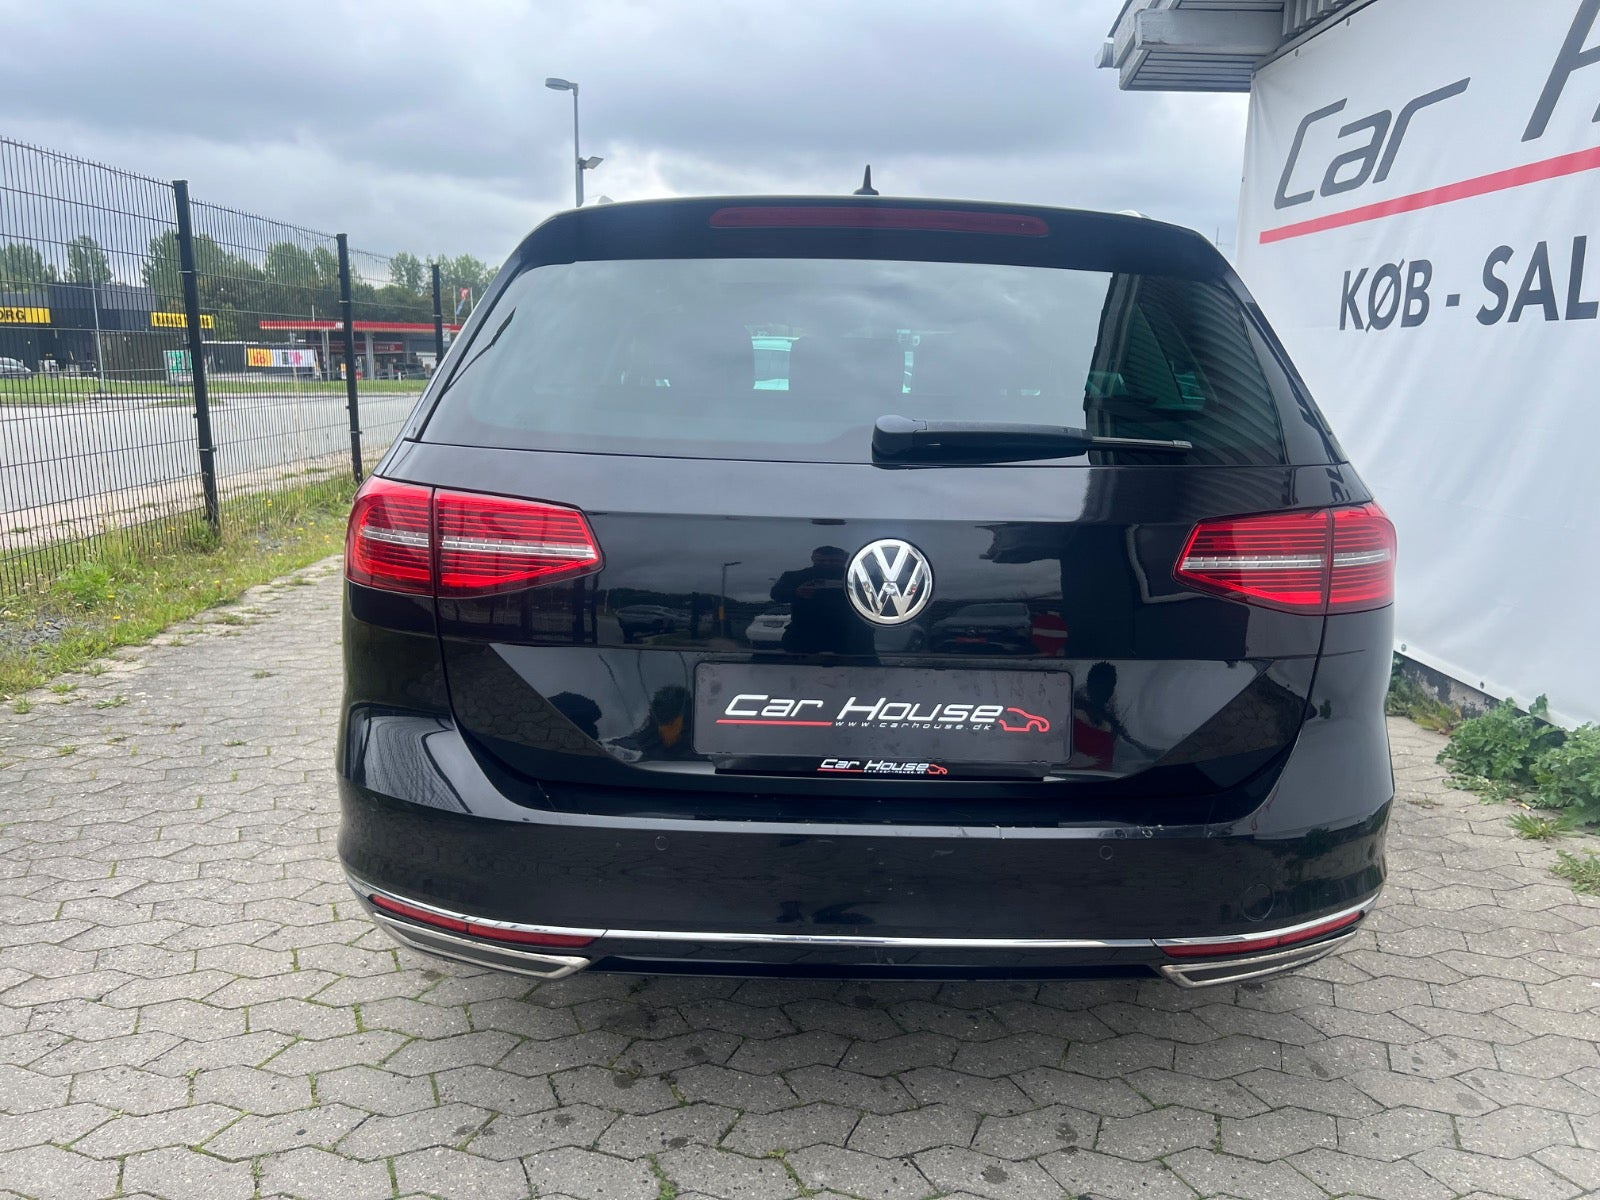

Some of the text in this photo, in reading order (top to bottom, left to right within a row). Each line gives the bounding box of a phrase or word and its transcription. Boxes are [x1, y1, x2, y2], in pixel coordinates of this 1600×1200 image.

[1274, 77, 1471, 209] Car
[1339, 258, 1433, 332] KØB
[1475, 235, 1599, 325] SAL
[725, 694, 1004, 723] Car House
[835, 721, 992, 731] www.carhouse.dk
[820, 758, 930, 771] Car House
